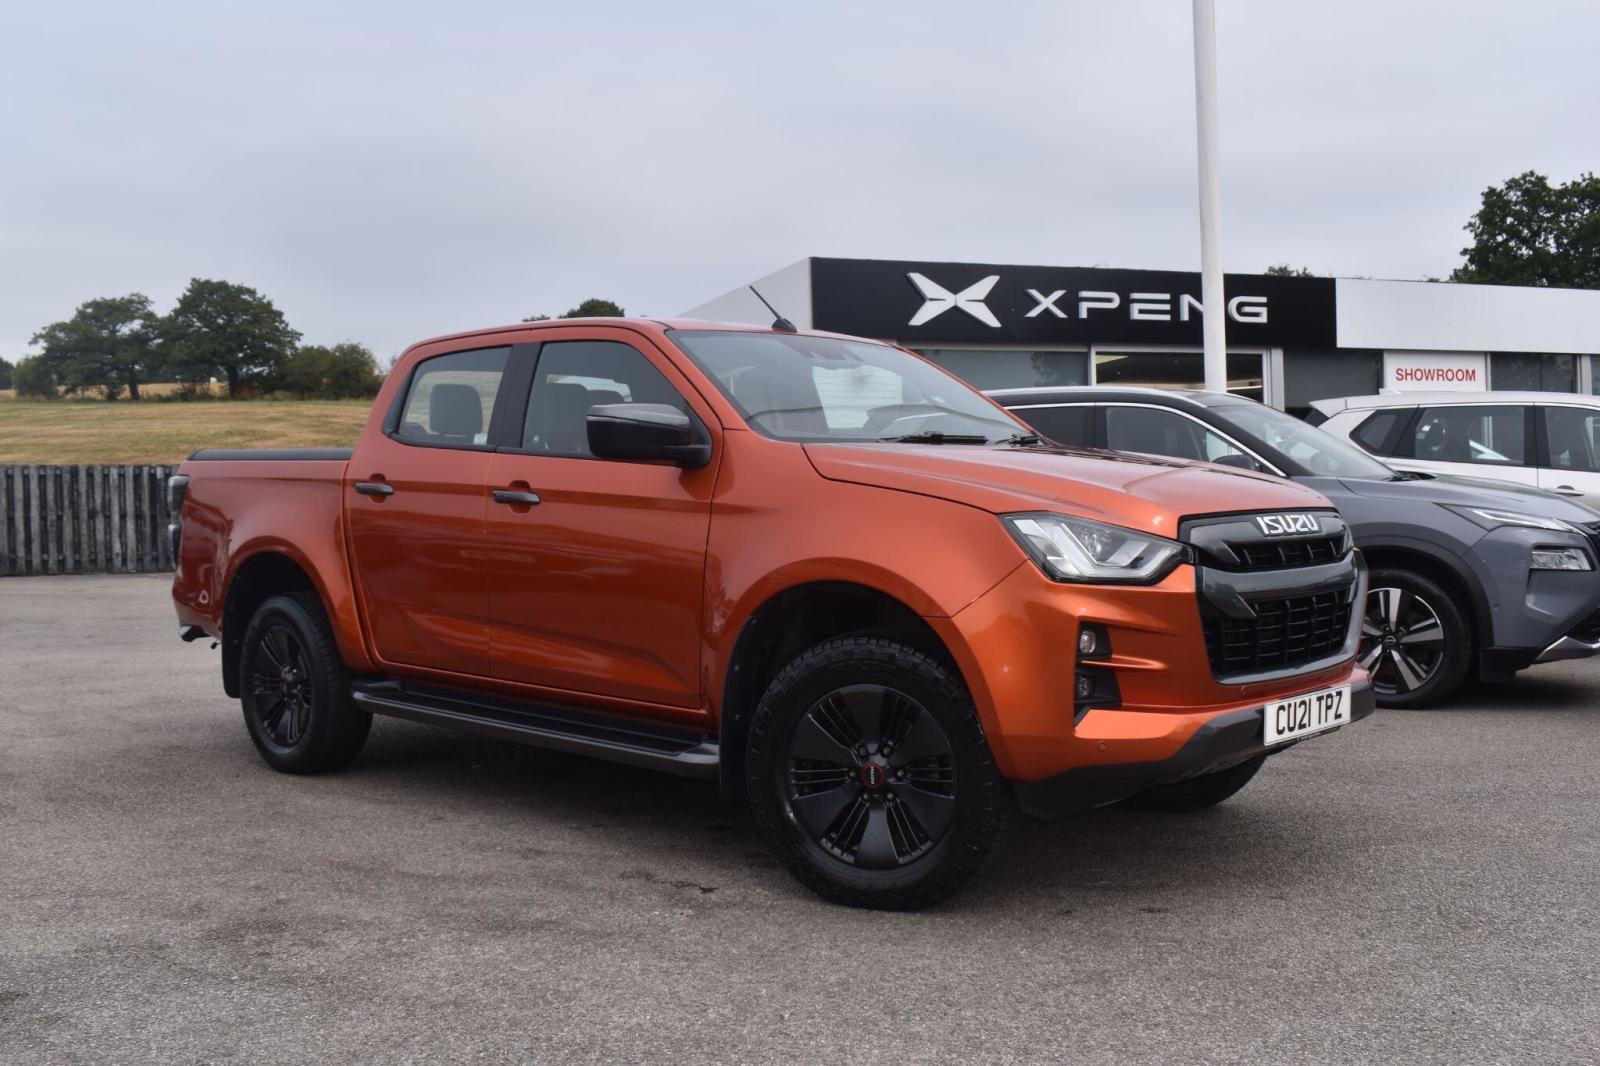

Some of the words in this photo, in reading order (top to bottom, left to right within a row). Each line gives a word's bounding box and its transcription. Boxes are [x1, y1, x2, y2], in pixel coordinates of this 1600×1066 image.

[1023, 288, 1268, 324] XPENG
[1395, 368, 1477, 382] SHOWROOM
[1255, 514, 1320, 534] ISUZU
[1276, 698, 1312, 736] CU21
[1316, 690, 1343, 725] TPZ
